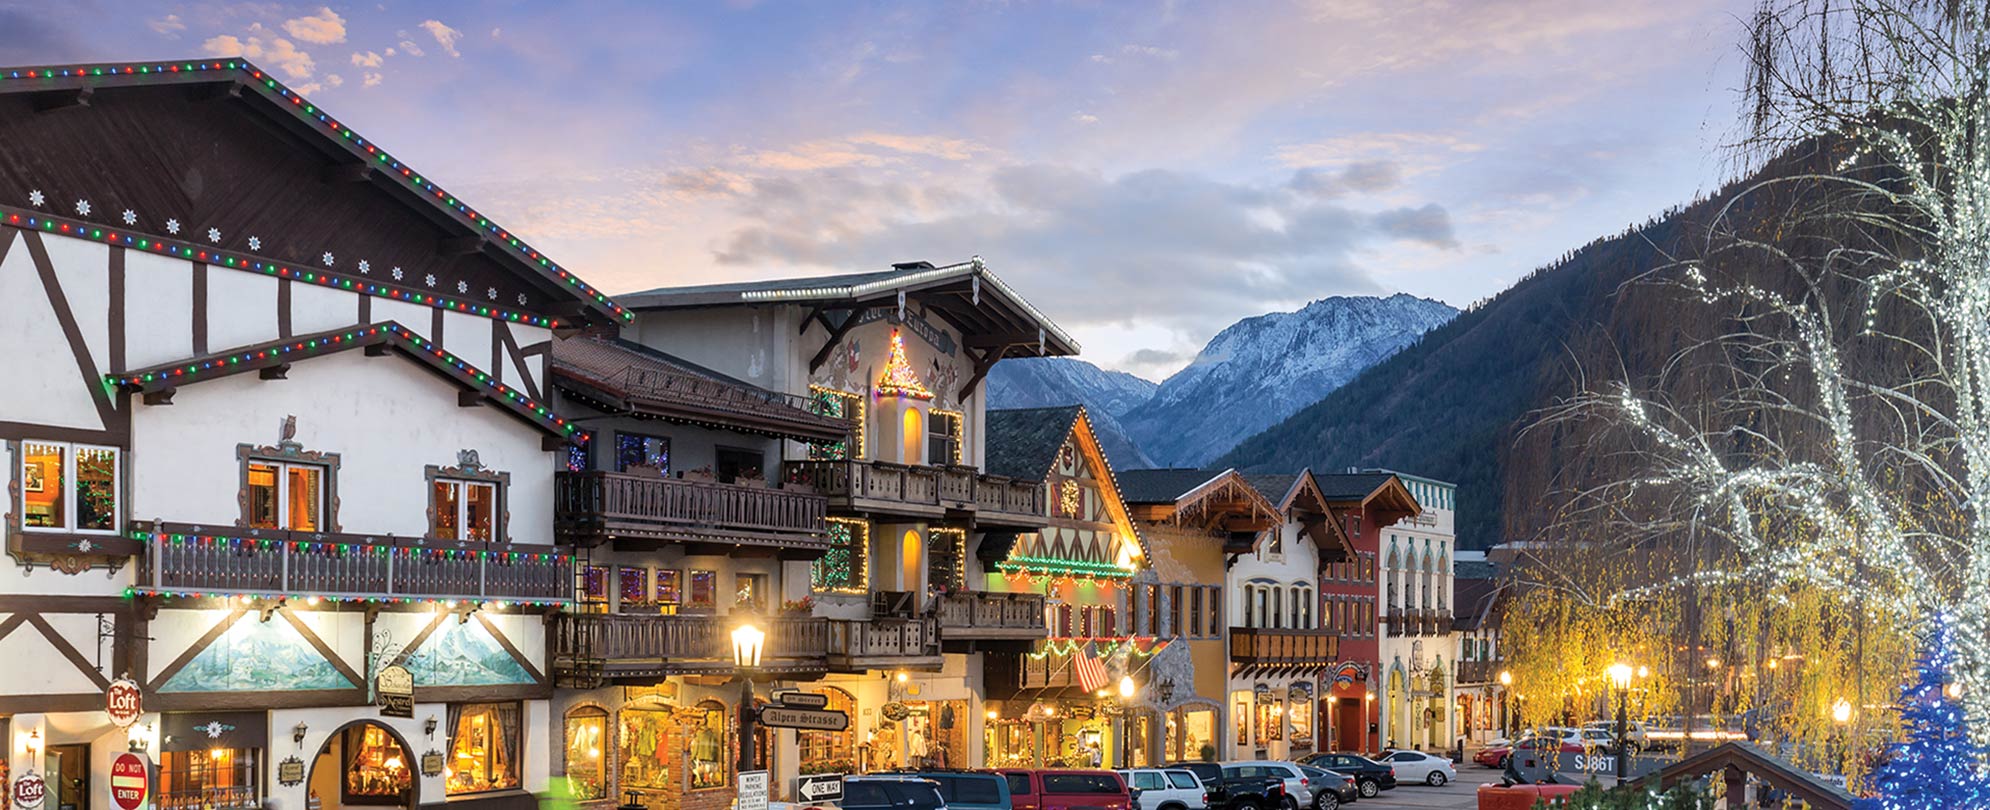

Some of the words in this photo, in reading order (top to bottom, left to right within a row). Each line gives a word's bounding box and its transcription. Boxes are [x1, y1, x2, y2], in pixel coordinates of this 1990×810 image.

[110, 691, 136, 710] Loft
[770, 711, 796, 723] Alpen
[800, 712, 837, 726] Strasse
[115, 762, 125, 773] DO
[128, 763, 142, 774] NOT
[1574, 754, 1615, 772] SJ86T
[746, 775, 761, 783] WINTER
[19, 783, 43, 797] Loft
[117, 789, 140, 800] ENTER
[812, 783, 825, 794] ONE
[826, 782, 839, 792] WAY
